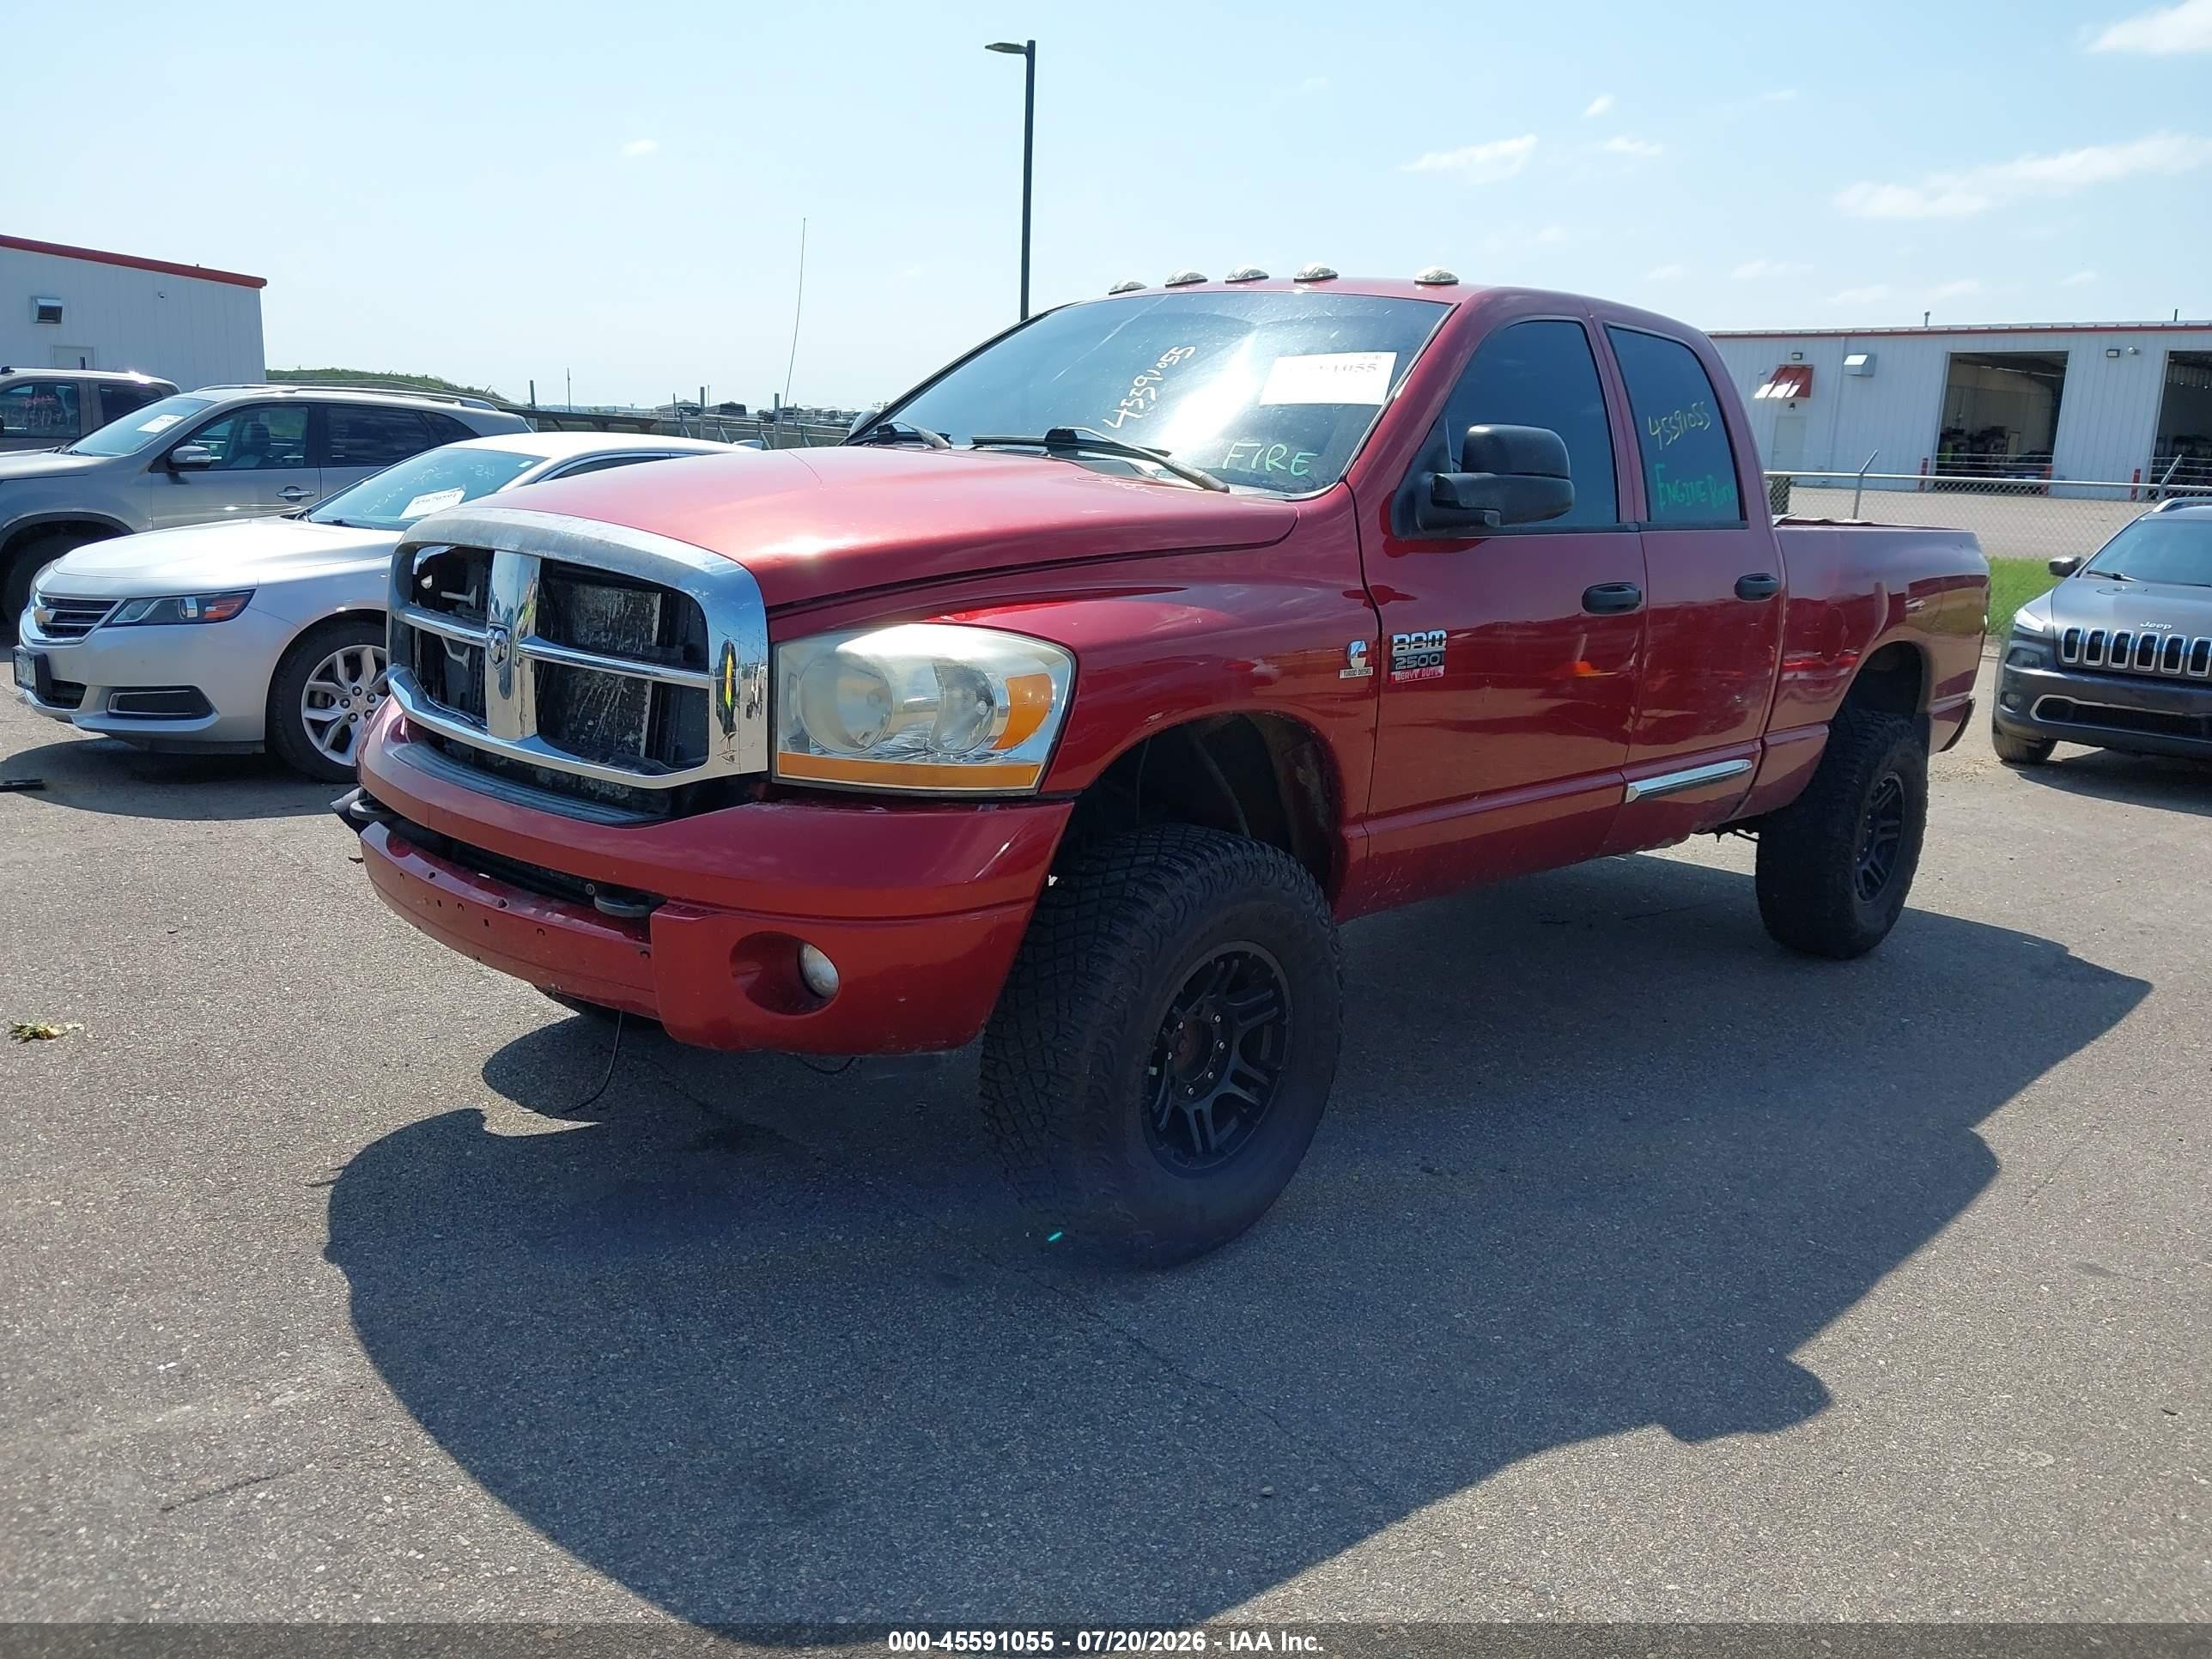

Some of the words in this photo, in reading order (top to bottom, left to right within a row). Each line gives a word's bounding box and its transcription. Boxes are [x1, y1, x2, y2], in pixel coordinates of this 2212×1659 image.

[1101, 346, 1196, 428] 45591055
[1648, 400, 1711, 451] 45591055
[1222, 441, 1319, 477] FIRE
[2139, 621, 2172, 630] Jeep
[1393, 630, 1447, 654] RAM
[1395, 653, 1441, 670] 2500
[1395, 669, 1420, 681] HEAVY
